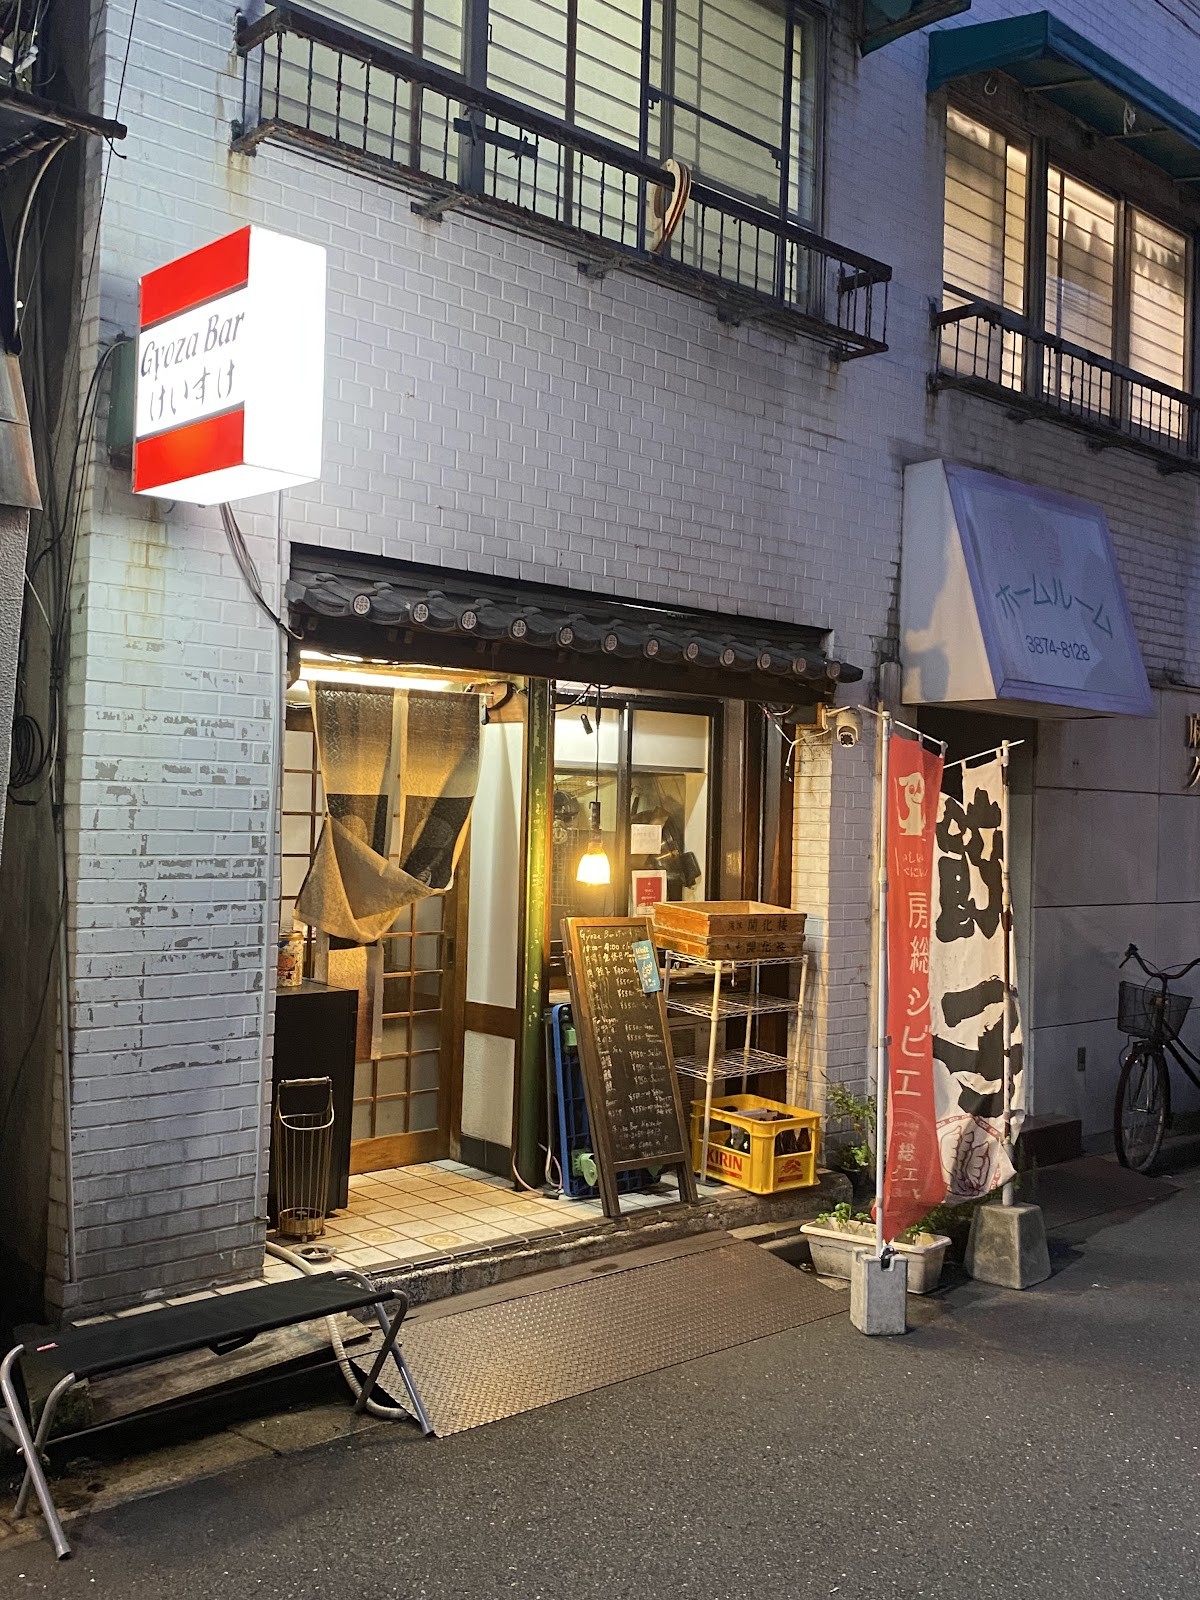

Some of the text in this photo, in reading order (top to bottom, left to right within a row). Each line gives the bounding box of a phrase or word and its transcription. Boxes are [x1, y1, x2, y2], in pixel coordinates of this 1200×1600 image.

[140, 312, 245, 381] Gyoza Bar
[150, 359, 235, 422] けいすけ
[995, 573, 1113, 639] ホームルーム
[1025, 635, 1090, 661] 3874-8128
[707, 1147, 743, 1172] KIRIN
